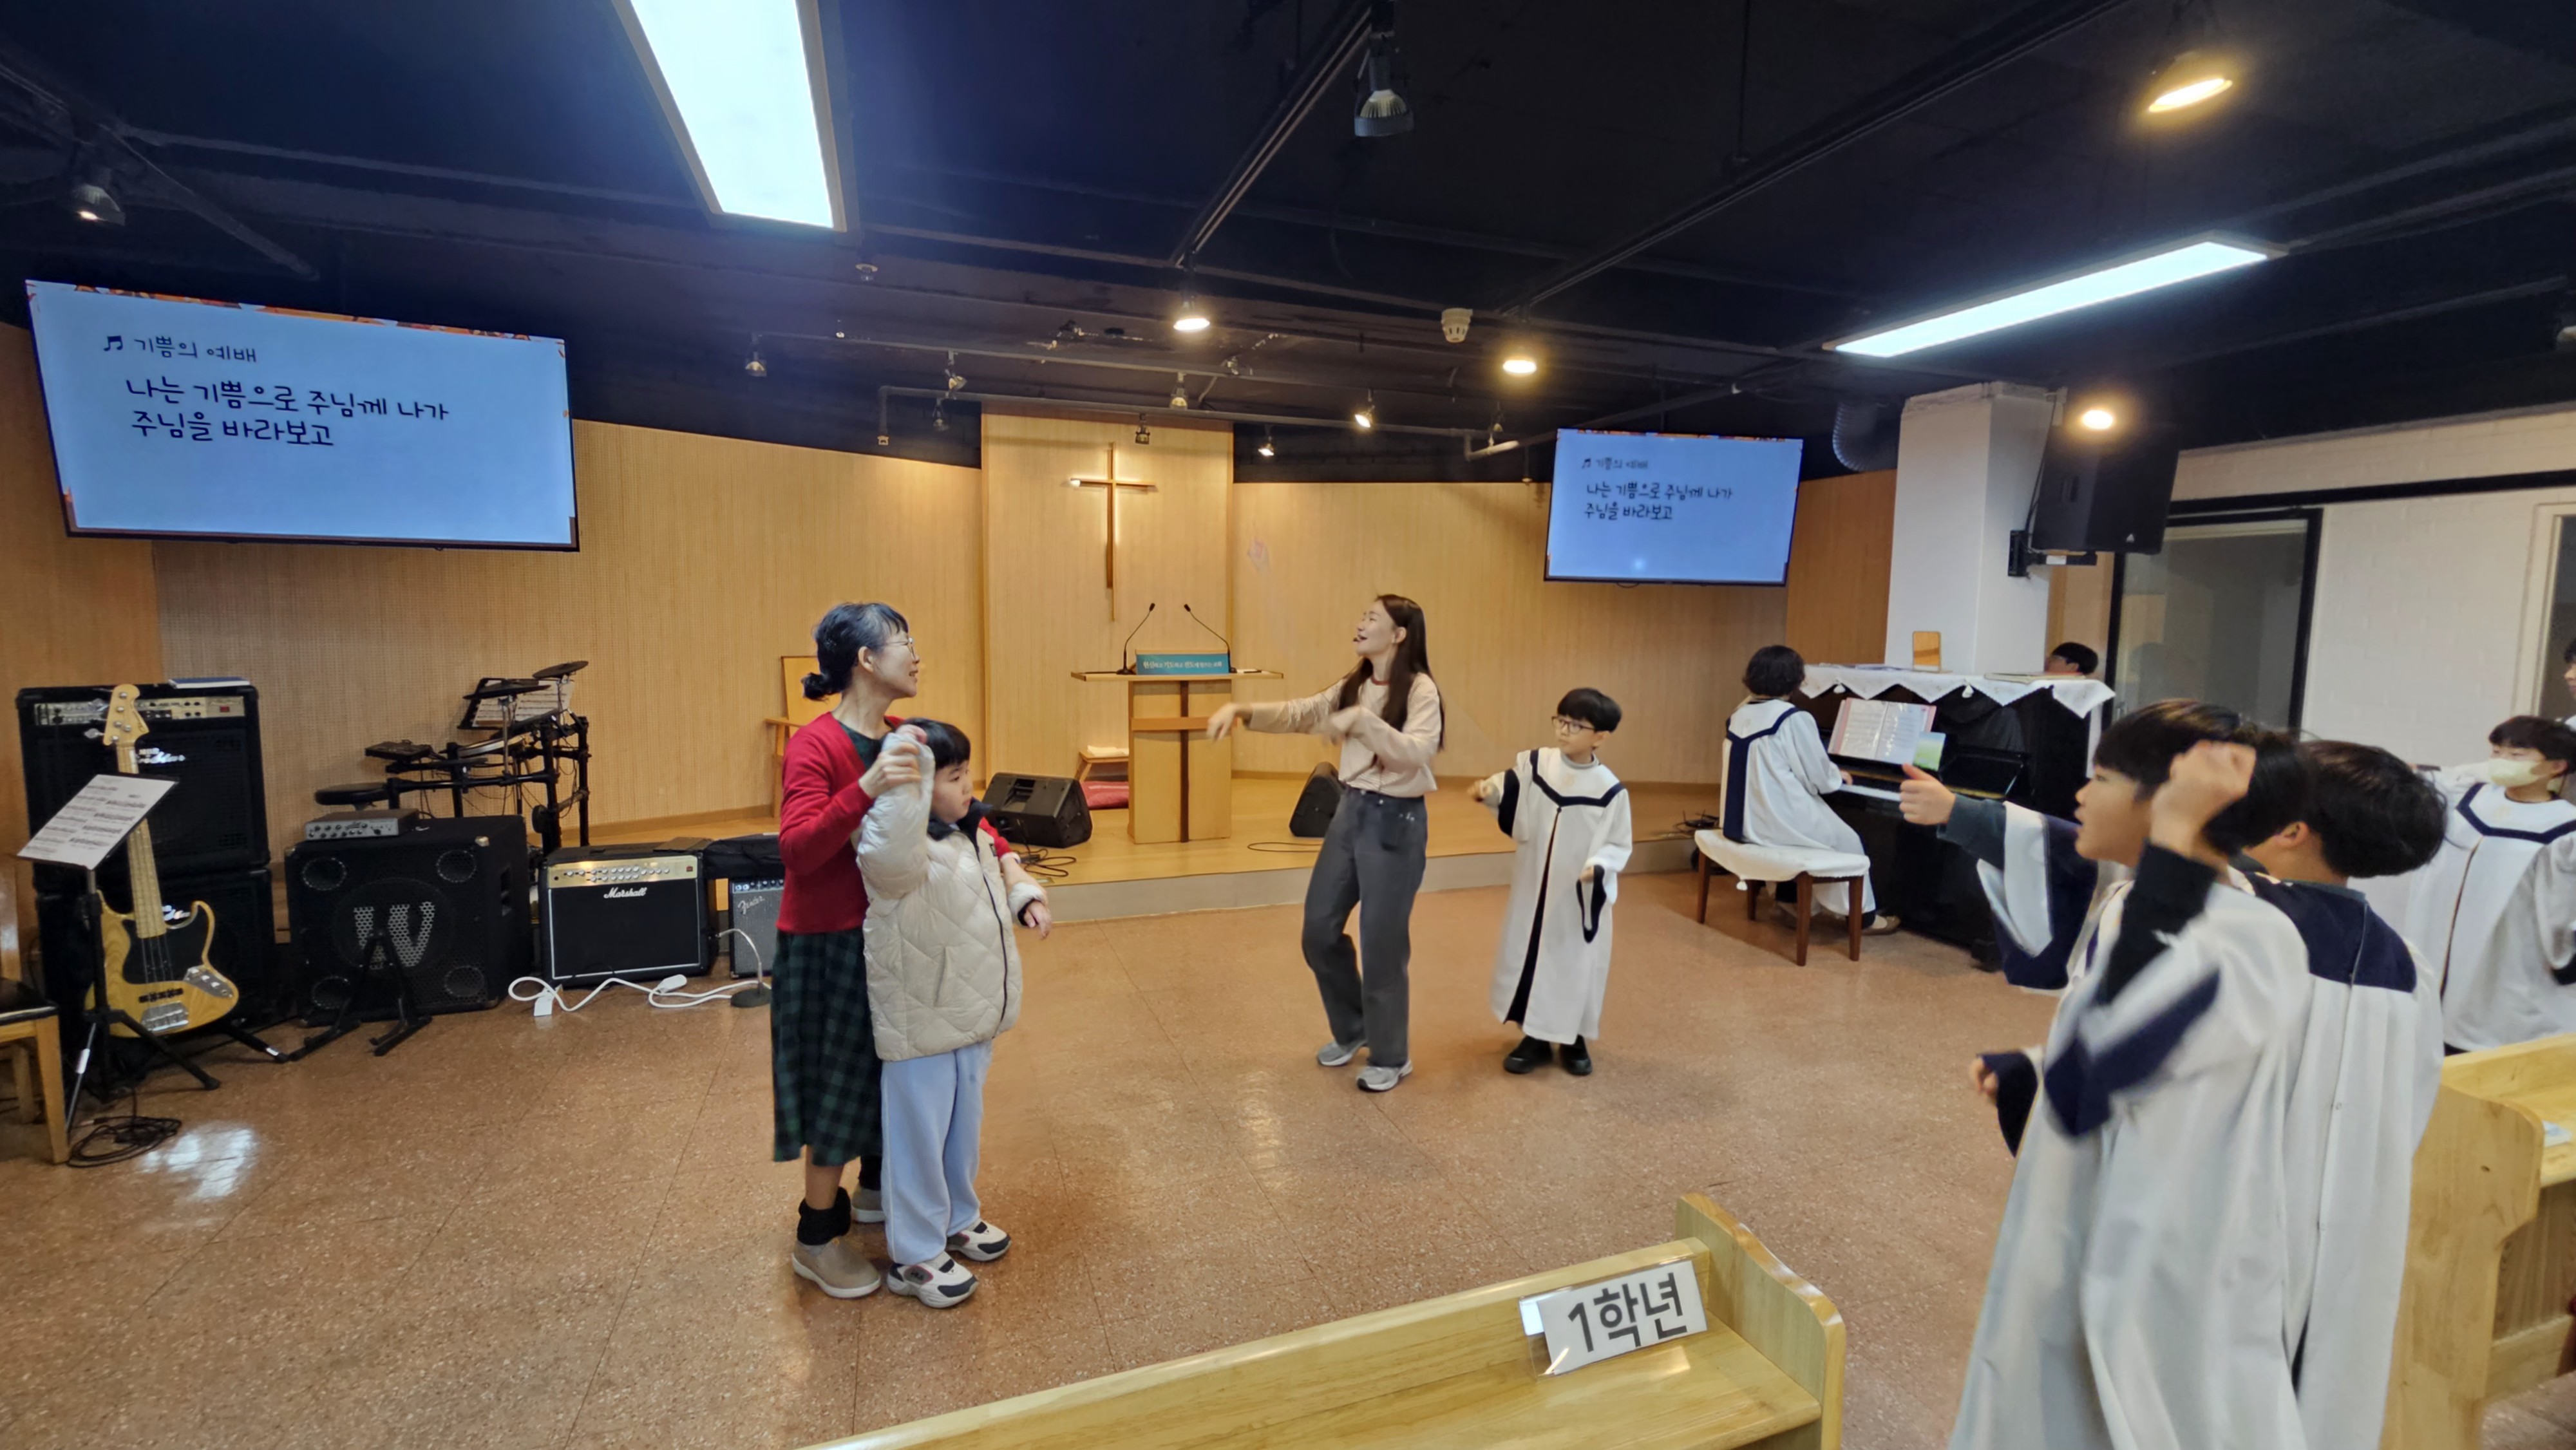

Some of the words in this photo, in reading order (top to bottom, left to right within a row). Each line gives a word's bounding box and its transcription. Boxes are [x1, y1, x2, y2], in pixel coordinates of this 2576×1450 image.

[134, 335, 198, 359] 기쁨의
[206, 345, 257, 362] 예배
[126, 375, 185, 404] 나는
[196, 380, 299, 413] 기쁨으로
[307, 390, 388, 418] 주님께
[397, 401, 450, 420] 나가
[131, 410, 213, 442] 주님을
[222, 419, 334, 446] 바라보고
[1587, 482, 1611, 498] 나는
[1616, 482, 1660, 499] 기쁨으로
[1665, 484, 1703, 501] 주님께
[1708, 488, 1732, 499] 나가
[1585, 502, 1619, 520] 주님을
[1623, 504, 1672, 520] 바라보고
[603, 887, 647, 899] Marshall
[1567, 1272, 1688, 1353] 1학년
